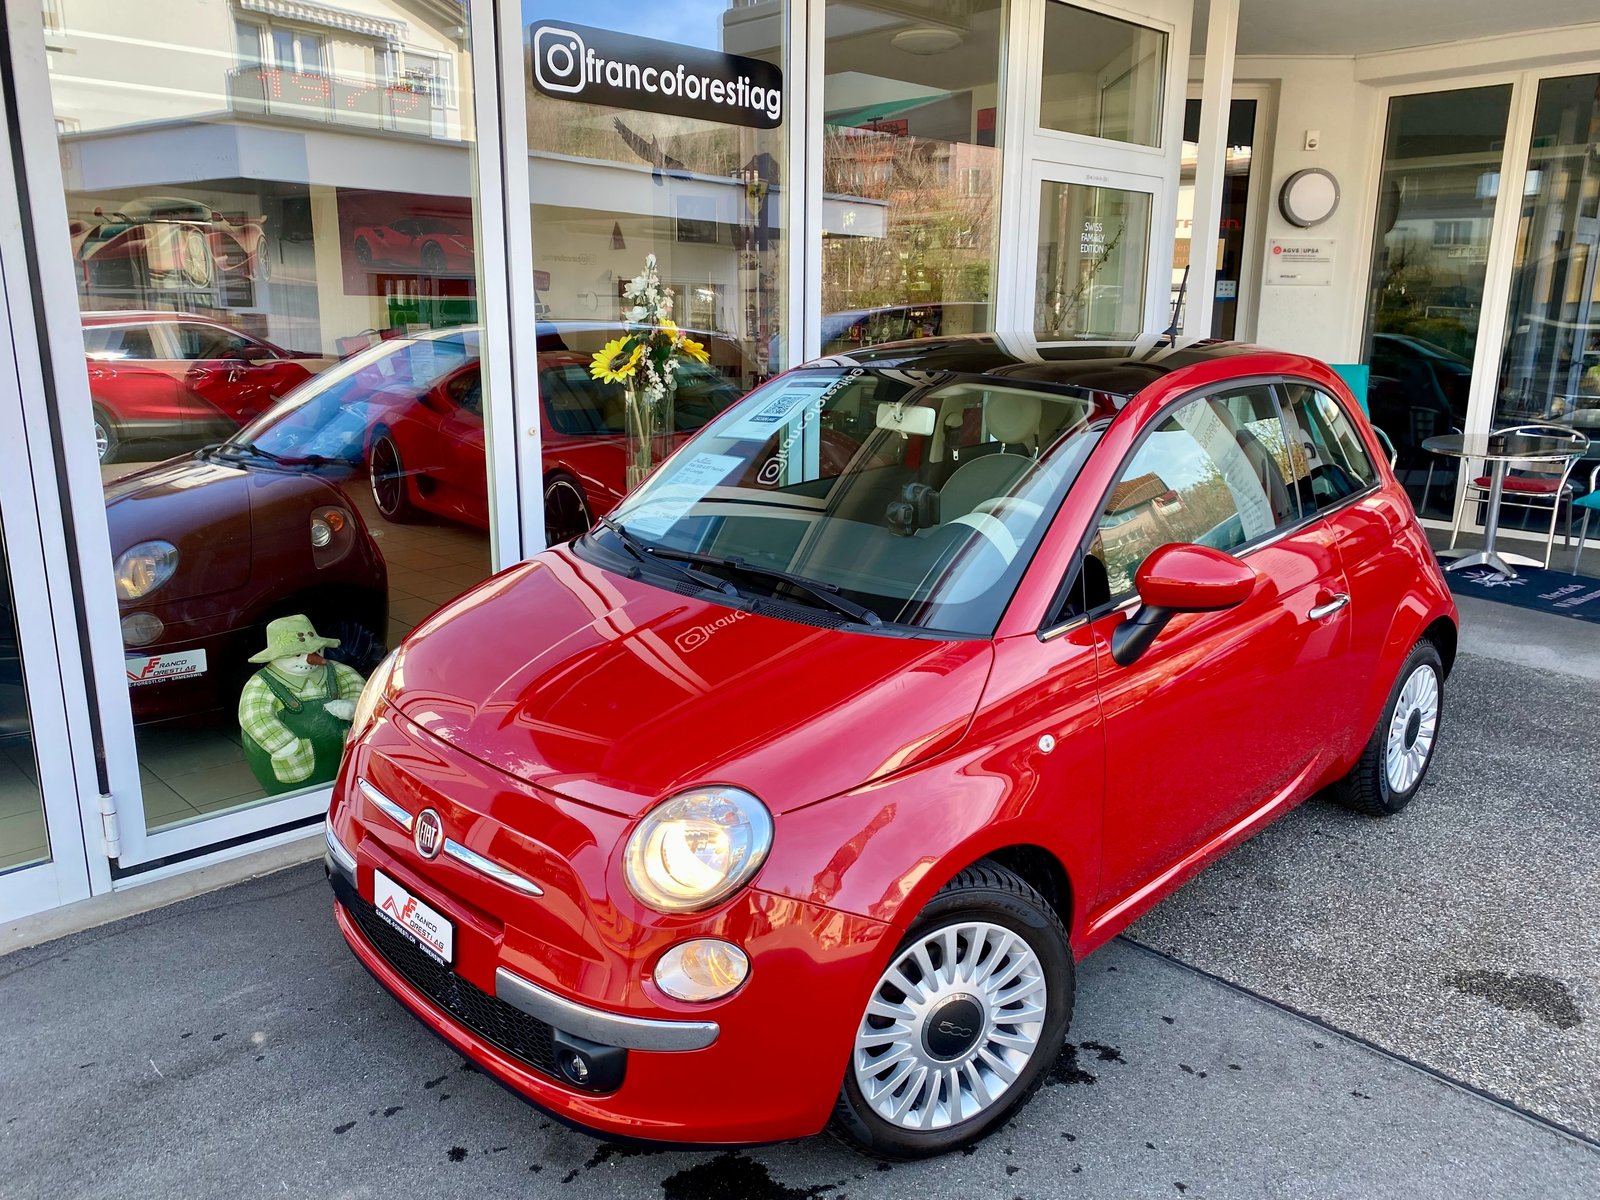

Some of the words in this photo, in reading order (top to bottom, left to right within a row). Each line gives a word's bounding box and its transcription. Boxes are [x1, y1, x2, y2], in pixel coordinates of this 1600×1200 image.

[586, 48, 781, 120] francoforestiag
[1084, 222, 1103, 232] SWISS
[1081, 232, 1105, 243] FAMILY
[1080, 243, 1104, 254] EDITION
[185, 664, 197, 672] AG
[420, 820, 438, 849] FIAT
[434, 938, 445, 950] AG
